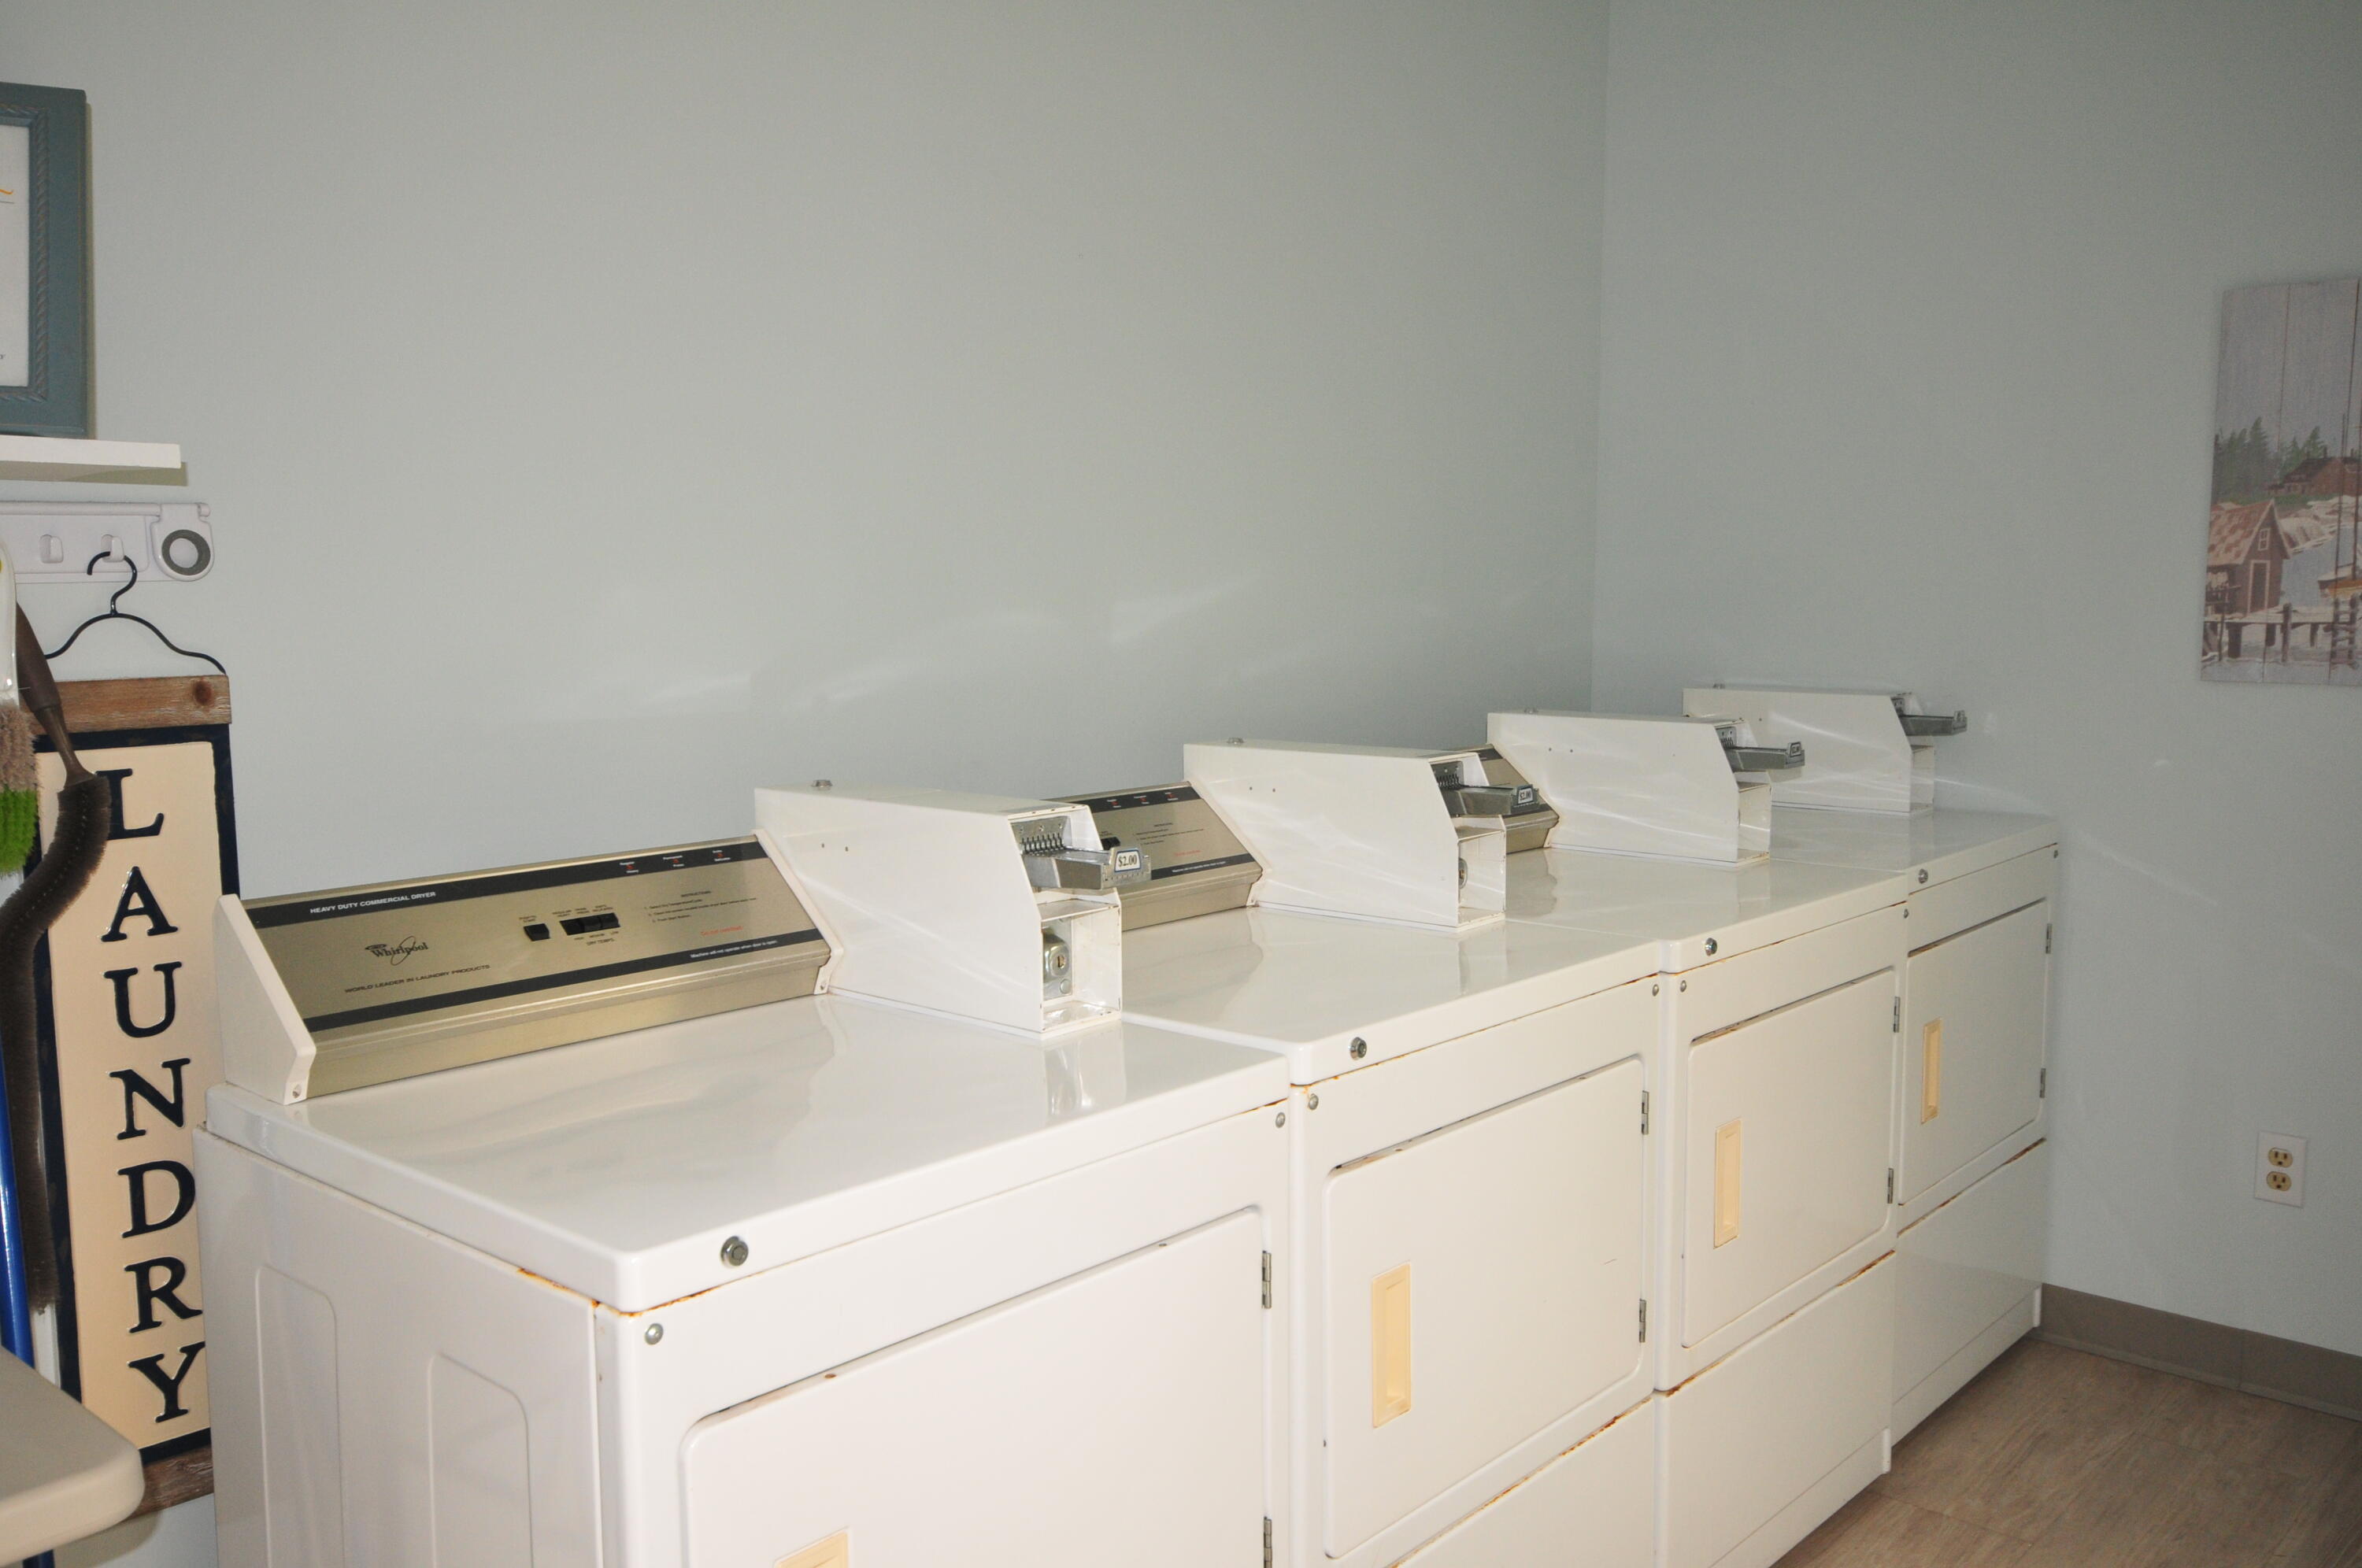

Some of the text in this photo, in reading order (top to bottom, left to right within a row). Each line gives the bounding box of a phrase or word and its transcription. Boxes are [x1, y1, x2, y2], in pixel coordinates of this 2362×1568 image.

[1118, 854, 1138, 867] $2.00
[309, 905, 336, 914] HEAVY
[360, 896, 409, 907] COMMERCIAL
[411, 891, 436, 900] DRYER
[370, 941, 429, 959] Whirlpool
[344, 985, 374, 993] WORLD
[375, 979, 405, 989] LEADER
[415, 971, 450, 982] LAUNDRY
[451, 964, 491, 974] PRODUCTS
[94, 768, 205, 1422] LAUNDRY
